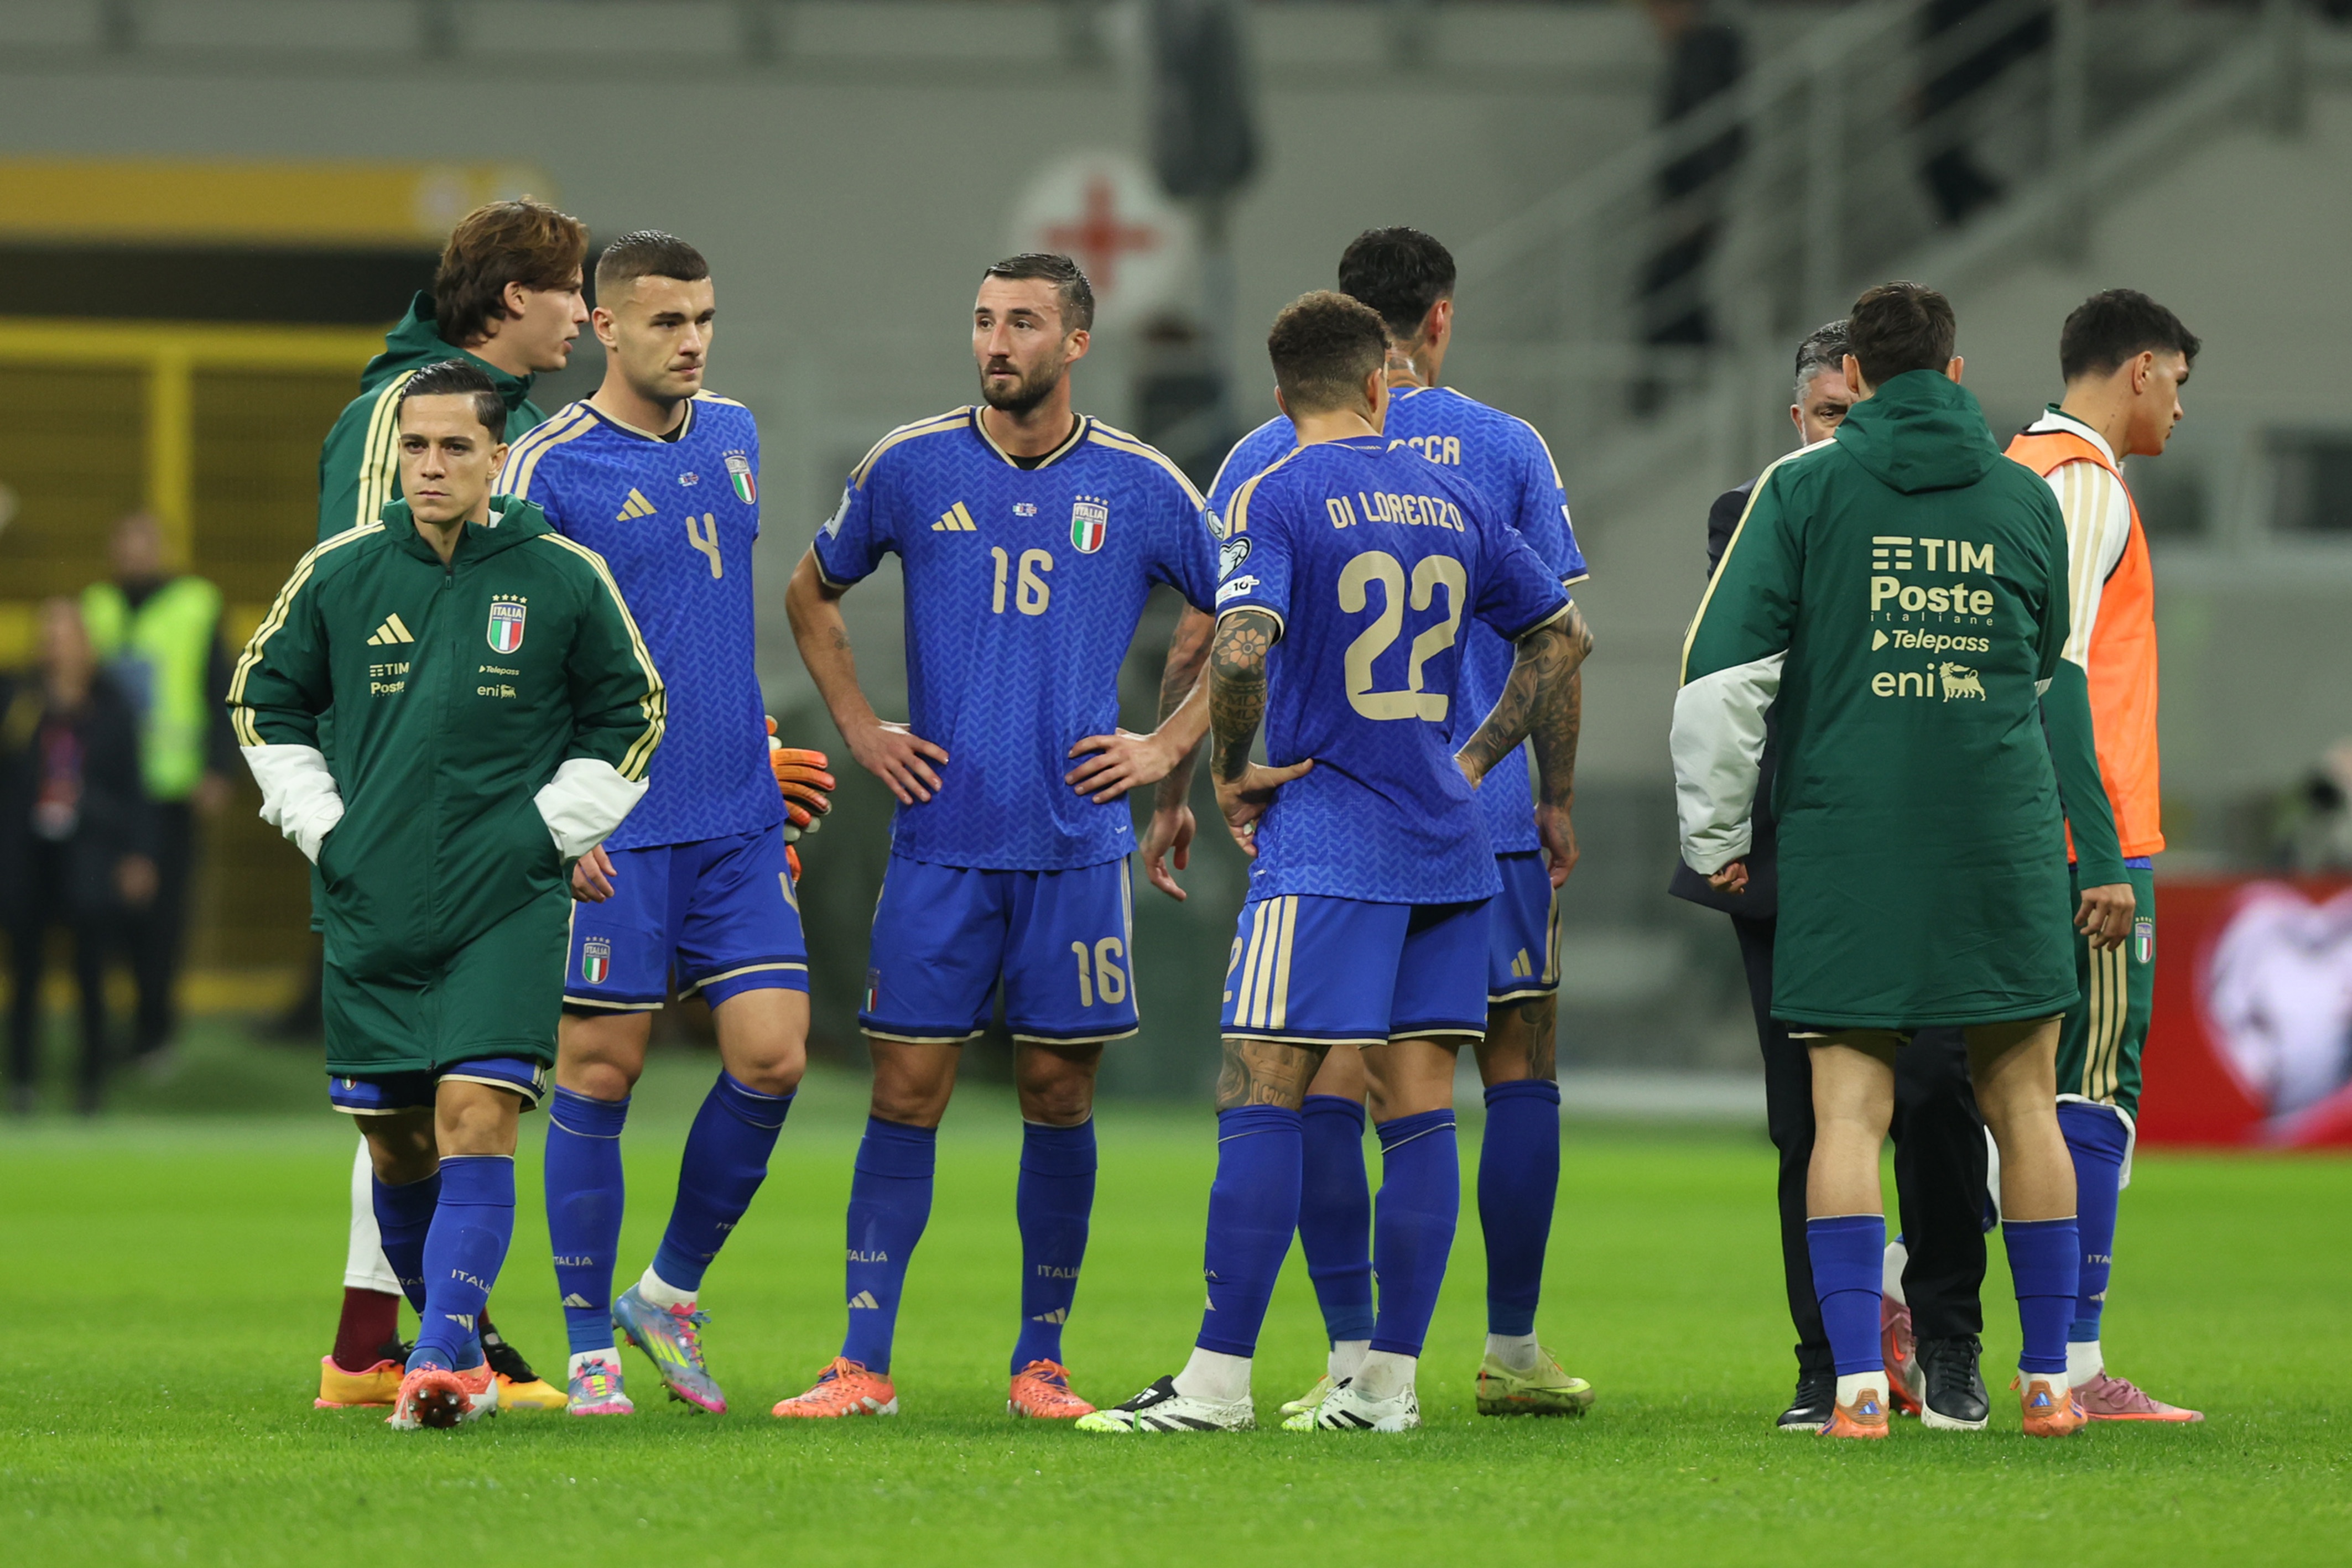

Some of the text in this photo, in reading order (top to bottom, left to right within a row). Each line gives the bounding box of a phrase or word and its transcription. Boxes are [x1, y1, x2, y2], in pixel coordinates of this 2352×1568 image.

[1075, 506, 1104, 520] ITALIA
[1325, 491, 1465, 533] DI LORENZO
[685, 512, 723, 579] 4
[1919, 537, 1994, 575] TIM
[991, 546, 1054, 616] 16
[1871, 576, 1994, 616] Poste
[493, 606, 522, 618] ITALIA
[1870, 612, 1994, 626] italiane
[1338, 550, 1467, 722] 22
[1892, 628, 1990, 654] Telepass
[384, 661, 410, 675] TIM
[486, 665, 520, 676] Telepass
[1871, 663, 1935, 697] eni
[477, 685, 499, 697] eni
[1071, 936, 1126, 1008] 16
